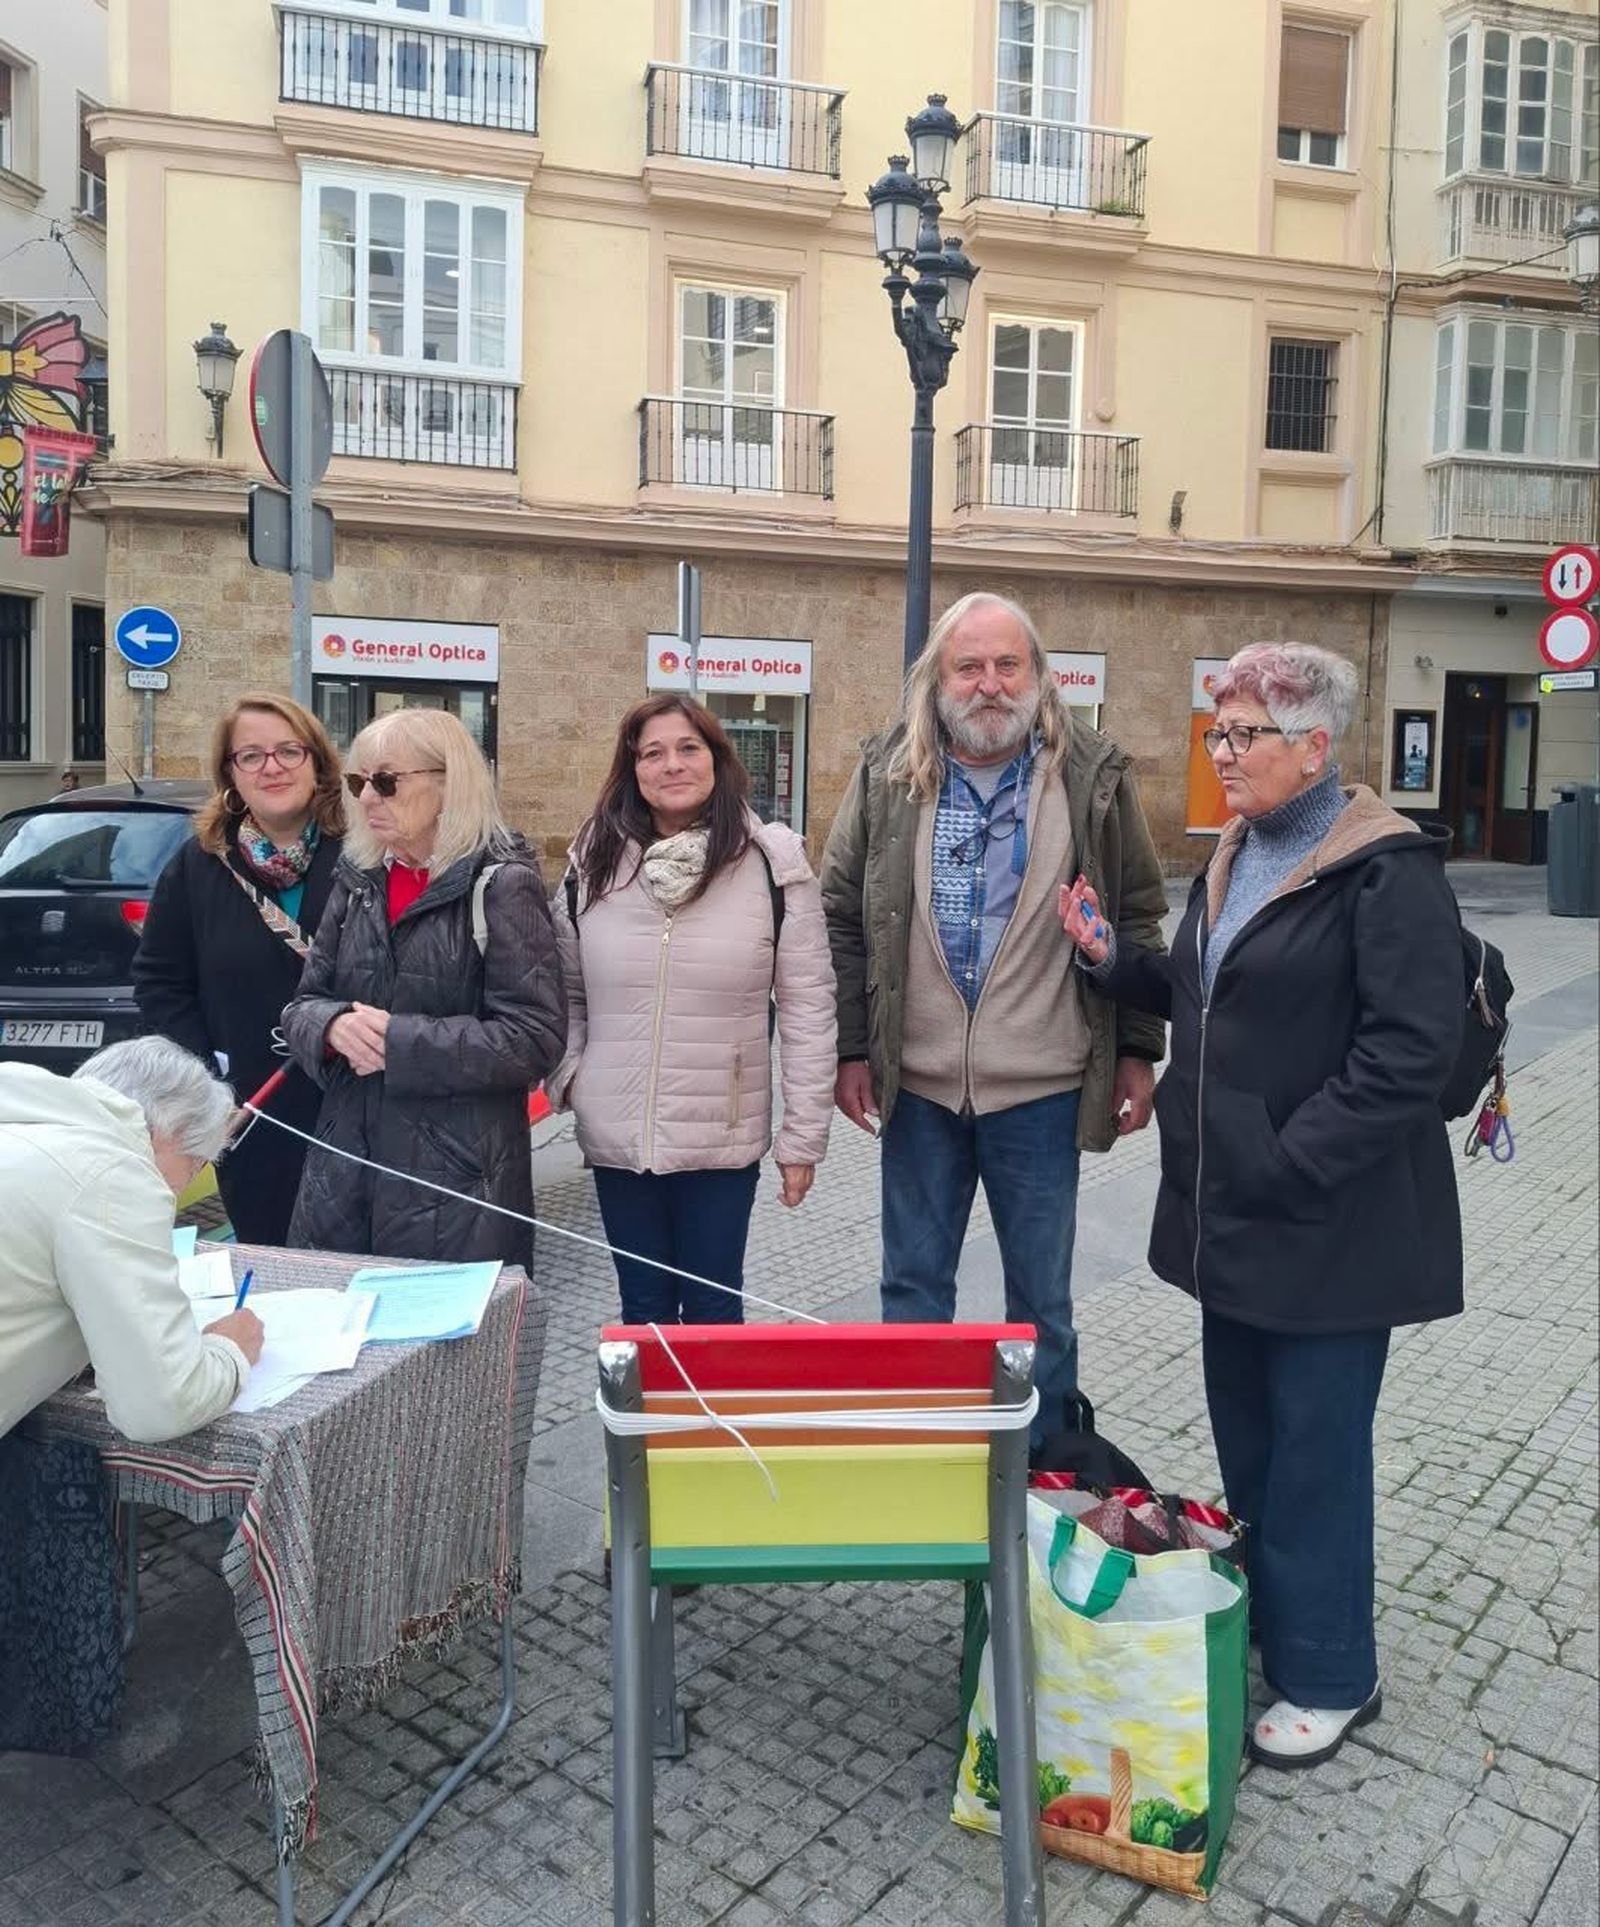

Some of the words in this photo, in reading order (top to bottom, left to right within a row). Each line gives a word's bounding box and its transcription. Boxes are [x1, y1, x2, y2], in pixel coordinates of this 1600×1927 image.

[352, 639, 423, 658] General
[428, 643, 486, 663] Optica
[751, 658, 802, 676] Optica
[15, 965, 61, 975] ALTEA
[6, 1023, 54, 1042] 3277
[59, 1023, 98, 1043] FTH
